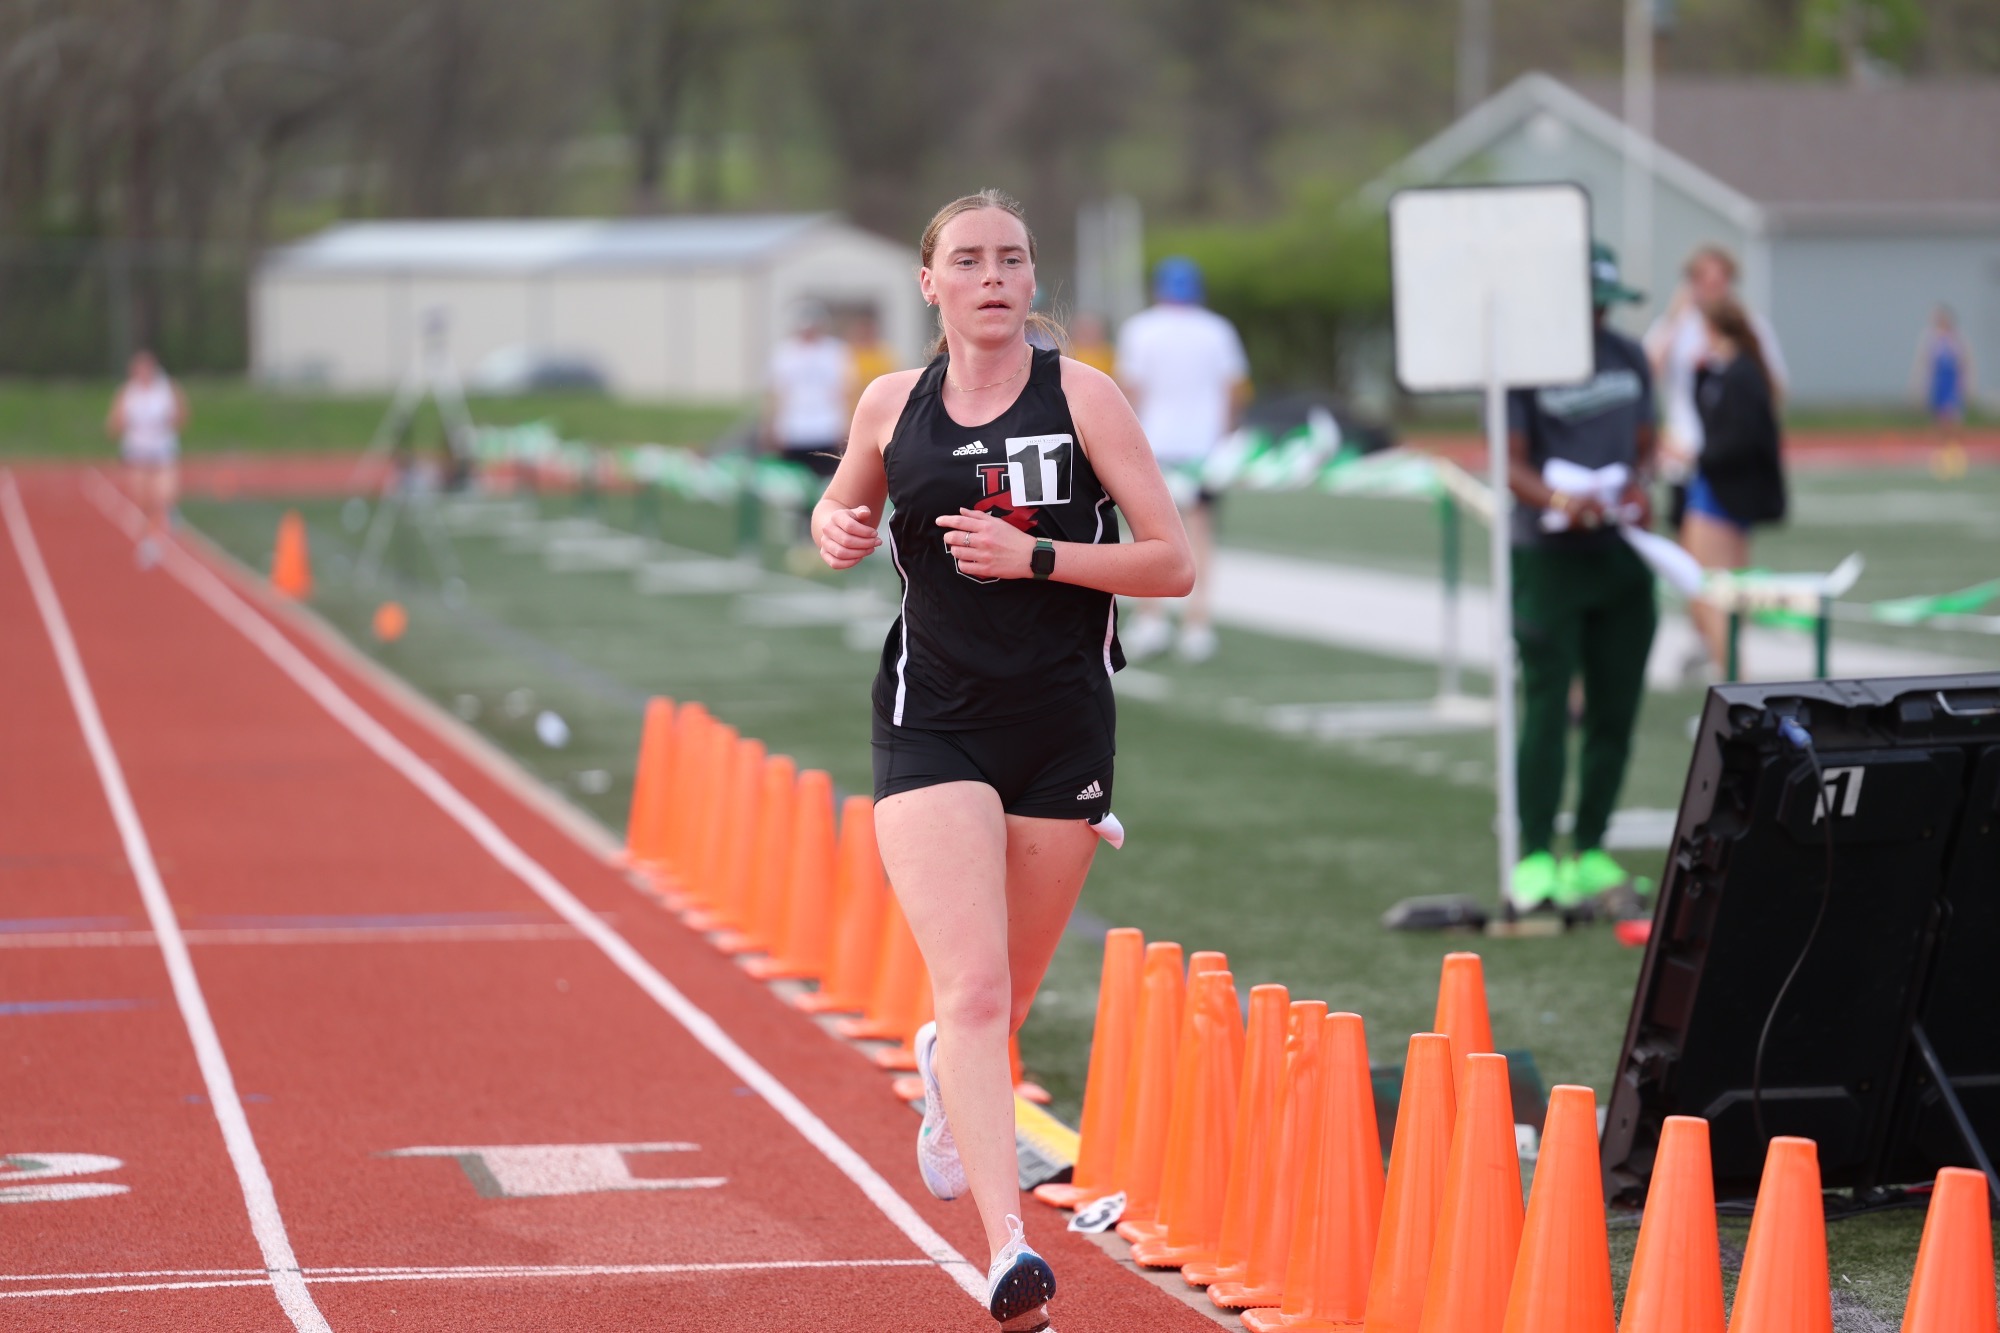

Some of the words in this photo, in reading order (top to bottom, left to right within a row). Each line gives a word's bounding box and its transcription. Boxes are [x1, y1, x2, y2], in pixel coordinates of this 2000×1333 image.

[952, 447, 989, 456] adidas
[1008, 443, 1072, 502] 11
[1076, 790, 1104, 800] adidas
